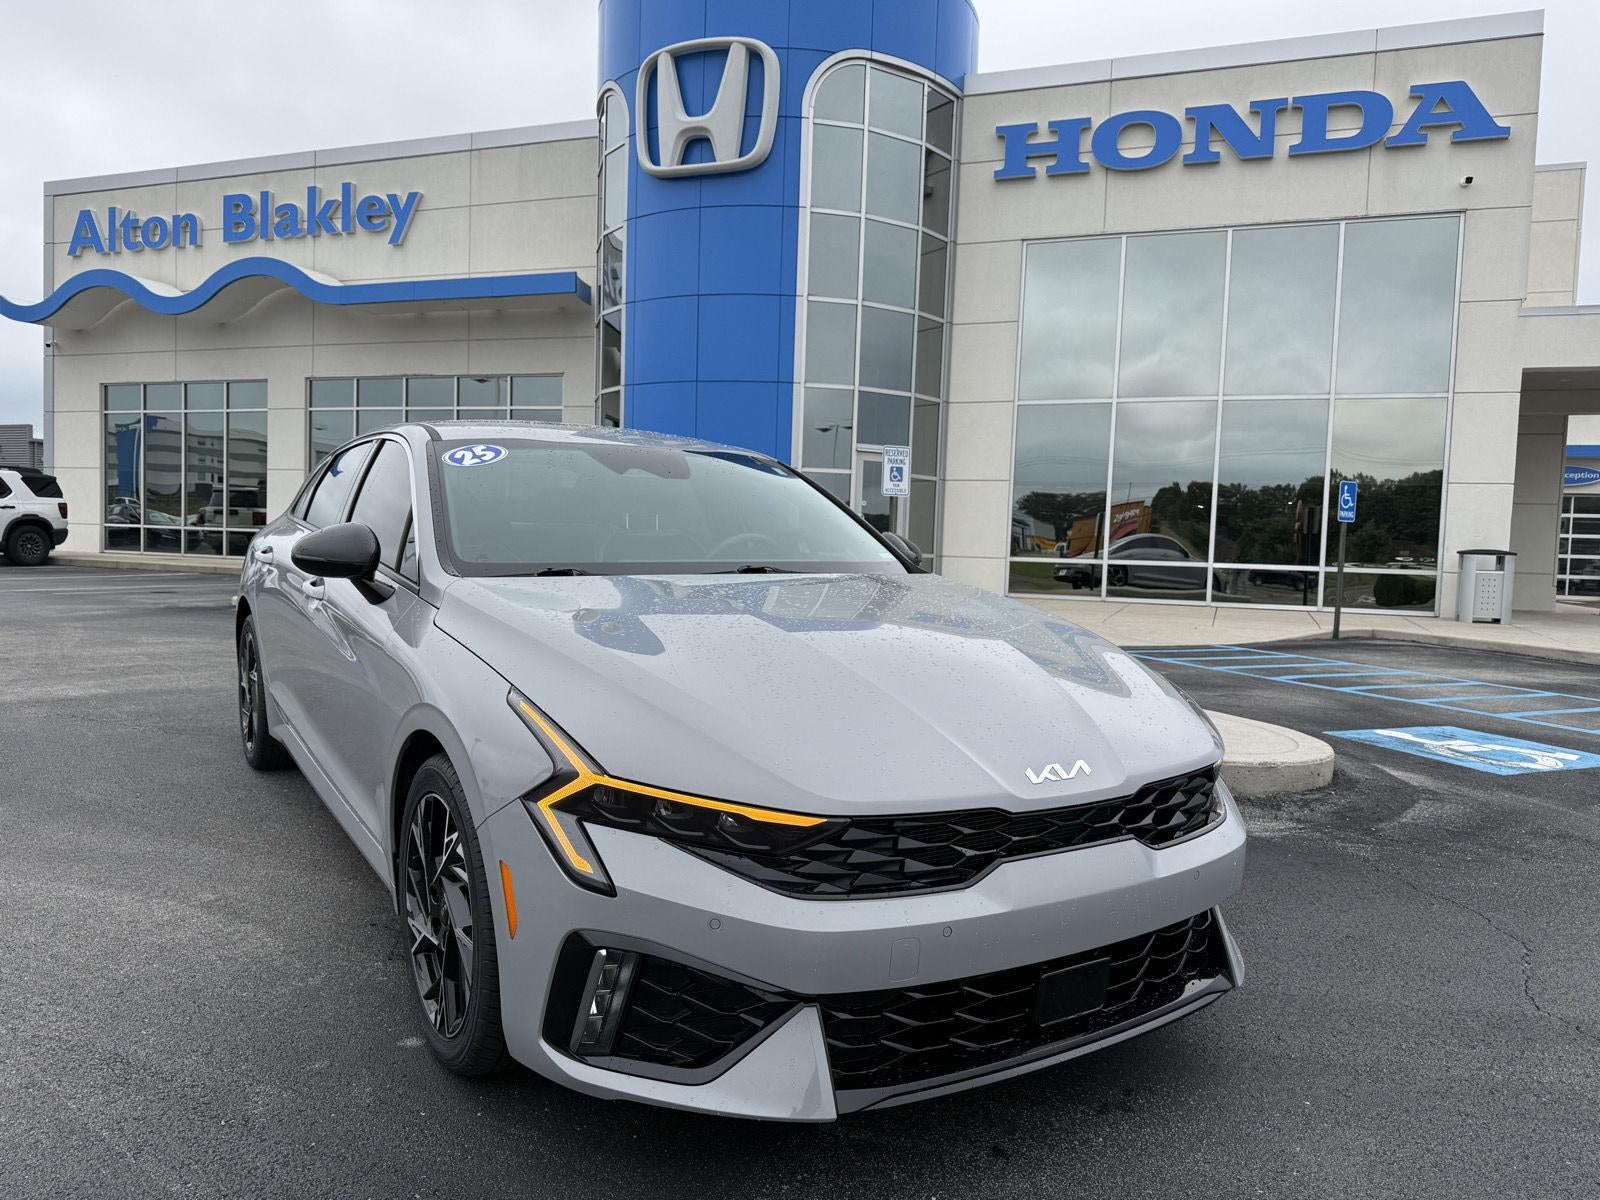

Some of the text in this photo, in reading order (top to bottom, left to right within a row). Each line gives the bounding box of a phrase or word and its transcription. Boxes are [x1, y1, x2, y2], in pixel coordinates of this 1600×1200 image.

[994, 80, 1511, 180] HONDA
[67, 182, 422, 257] Alton Blakley
[454, 445, 496, 465] 25
[885, 448, 908, 458] RESERVED
[887, 457, 906, 465] PARKING
